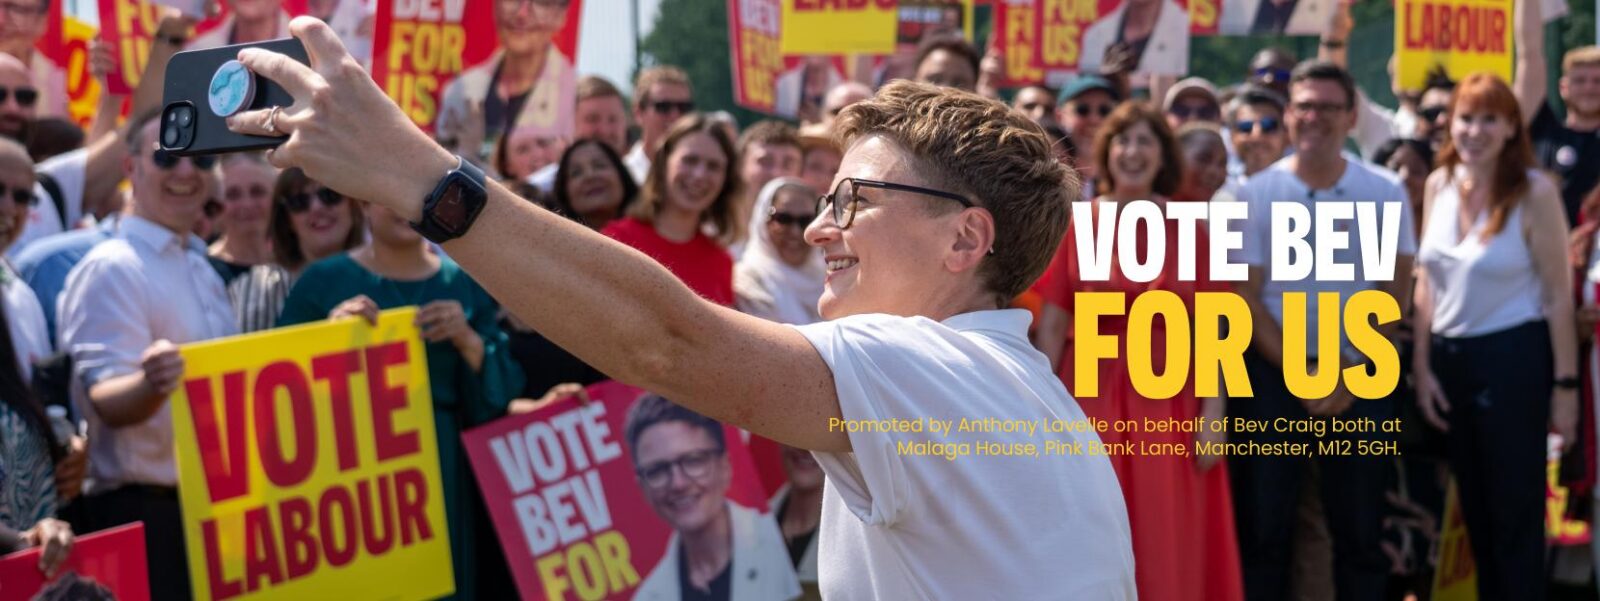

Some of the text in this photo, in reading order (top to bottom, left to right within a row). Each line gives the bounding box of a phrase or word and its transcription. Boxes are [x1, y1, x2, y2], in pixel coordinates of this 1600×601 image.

[389, 20, 467, 74] FOR
[1042, 24, 1079, 66] US
[1405, 0, 1507, 54] LABOUR
[184, 340, 423, 504] VOTE
[489, 401, 623, 495] VOTE
[201, 467, 434, 601] LABOUR
[512, 469, 613, 557] BEV
[535, 530, 641, 601] FOR
